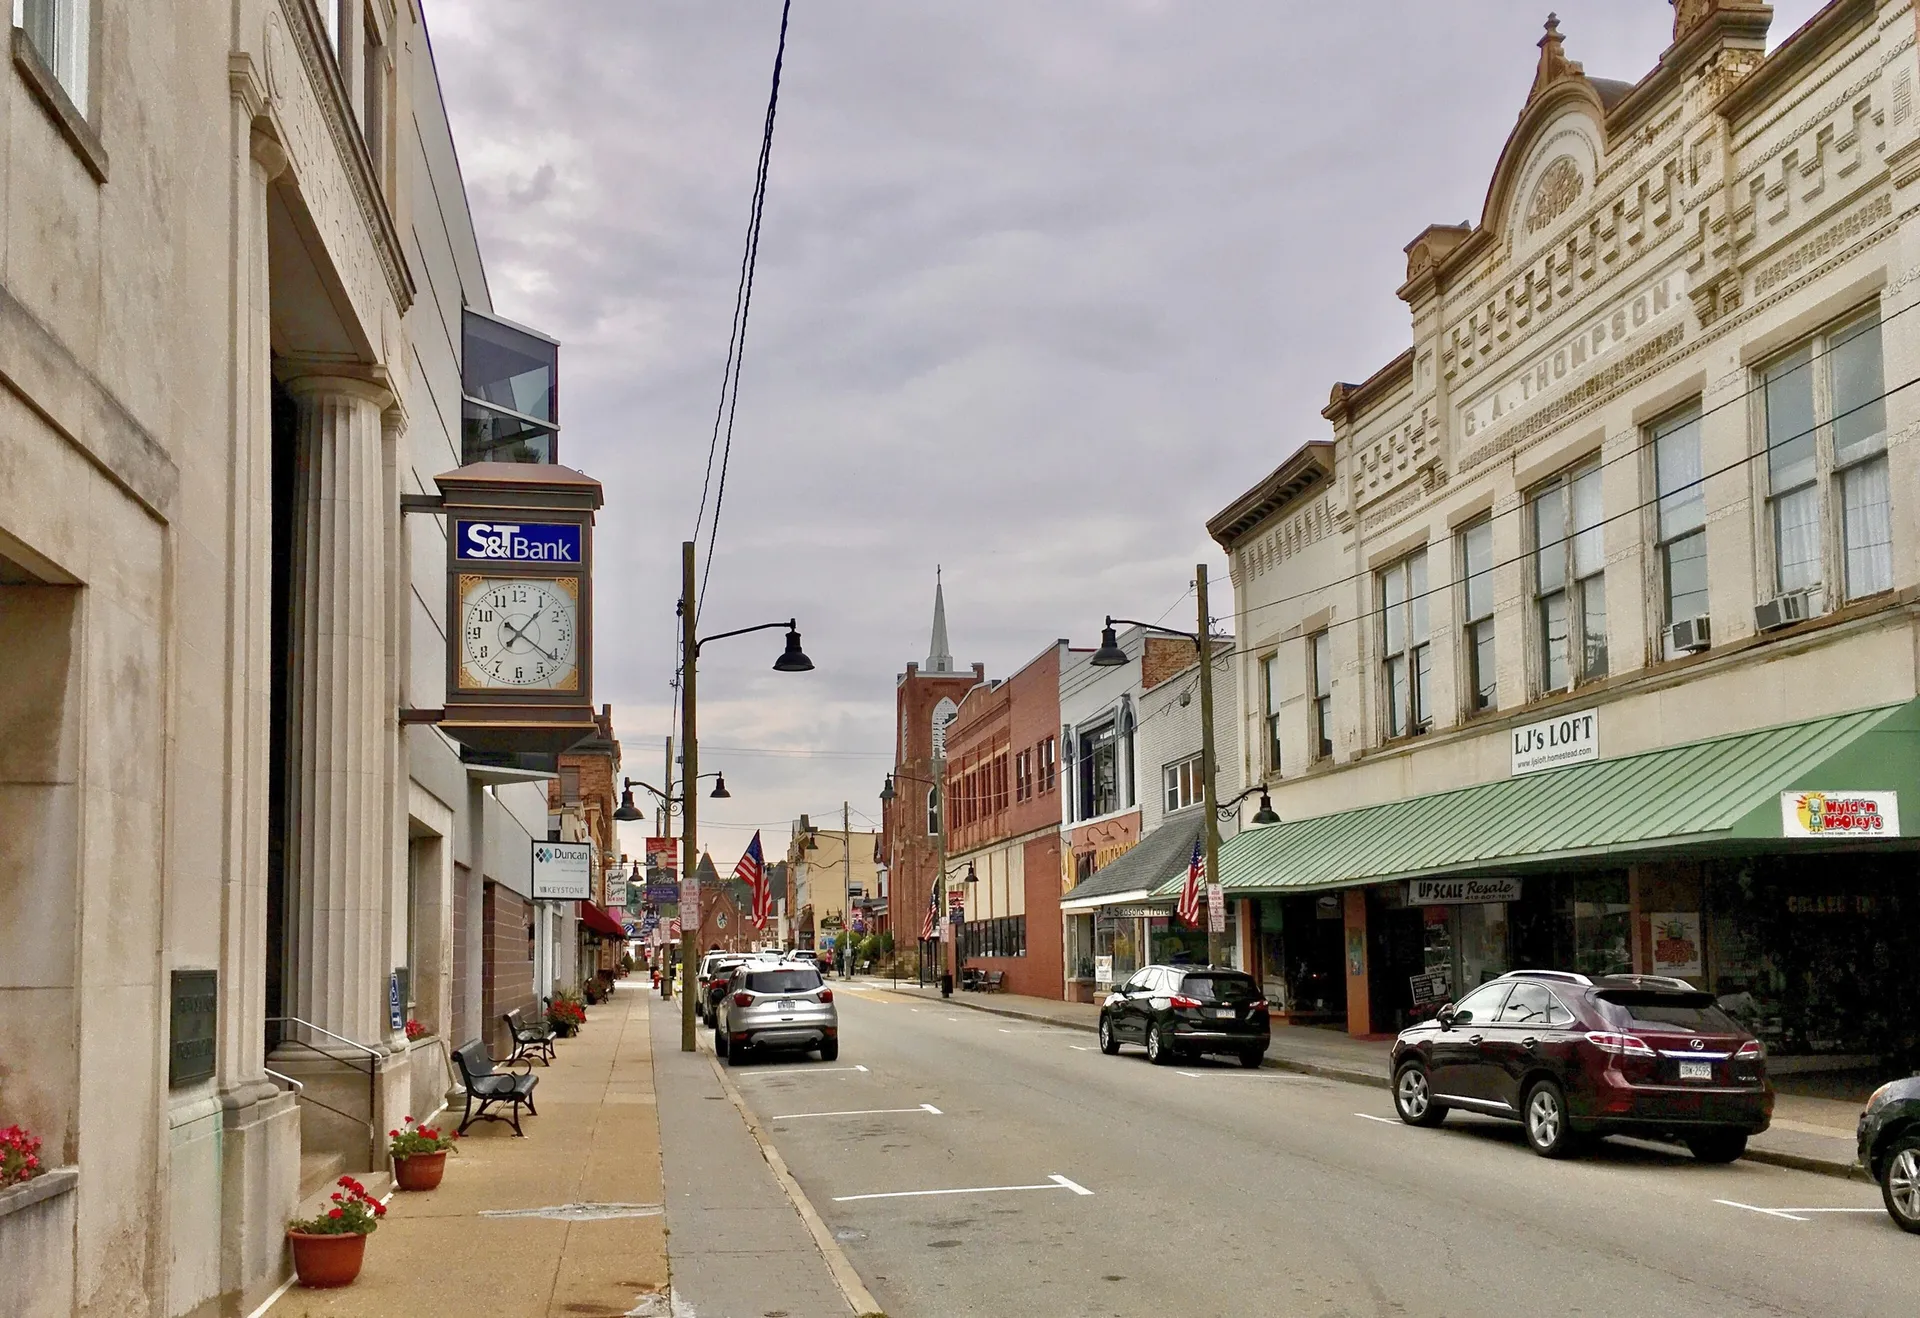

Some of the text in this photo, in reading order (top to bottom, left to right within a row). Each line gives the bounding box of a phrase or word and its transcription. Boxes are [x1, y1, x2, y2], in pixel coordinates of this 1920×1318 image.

[467, 523, 572, 560] S&T Bank
[493, 594, 507, 608] 11
[512, 589, 527, 603] 12
[537, 594, 544, 609] 1
[478, 609, 493, 622] 10
[472, 627, 482, 639] 9
[480, 645, 488, 658] 8
[495, 660, 504, 674] 7
[515, 666, 524, 679] 6
[535, 661, 544, 674] 5
[1515, 715, 1593, 755] LJ's LOFT
[1517, 747, 1592, 769] www.ljsloft.homestead.com
[554, 848, 588, 860] Duncan
[547, 886, 584, 894] KEYSTONE
[1467, 880, 1514, 895] Resale
[1106, 906, 1171, 917] 4 Seasons Travel
